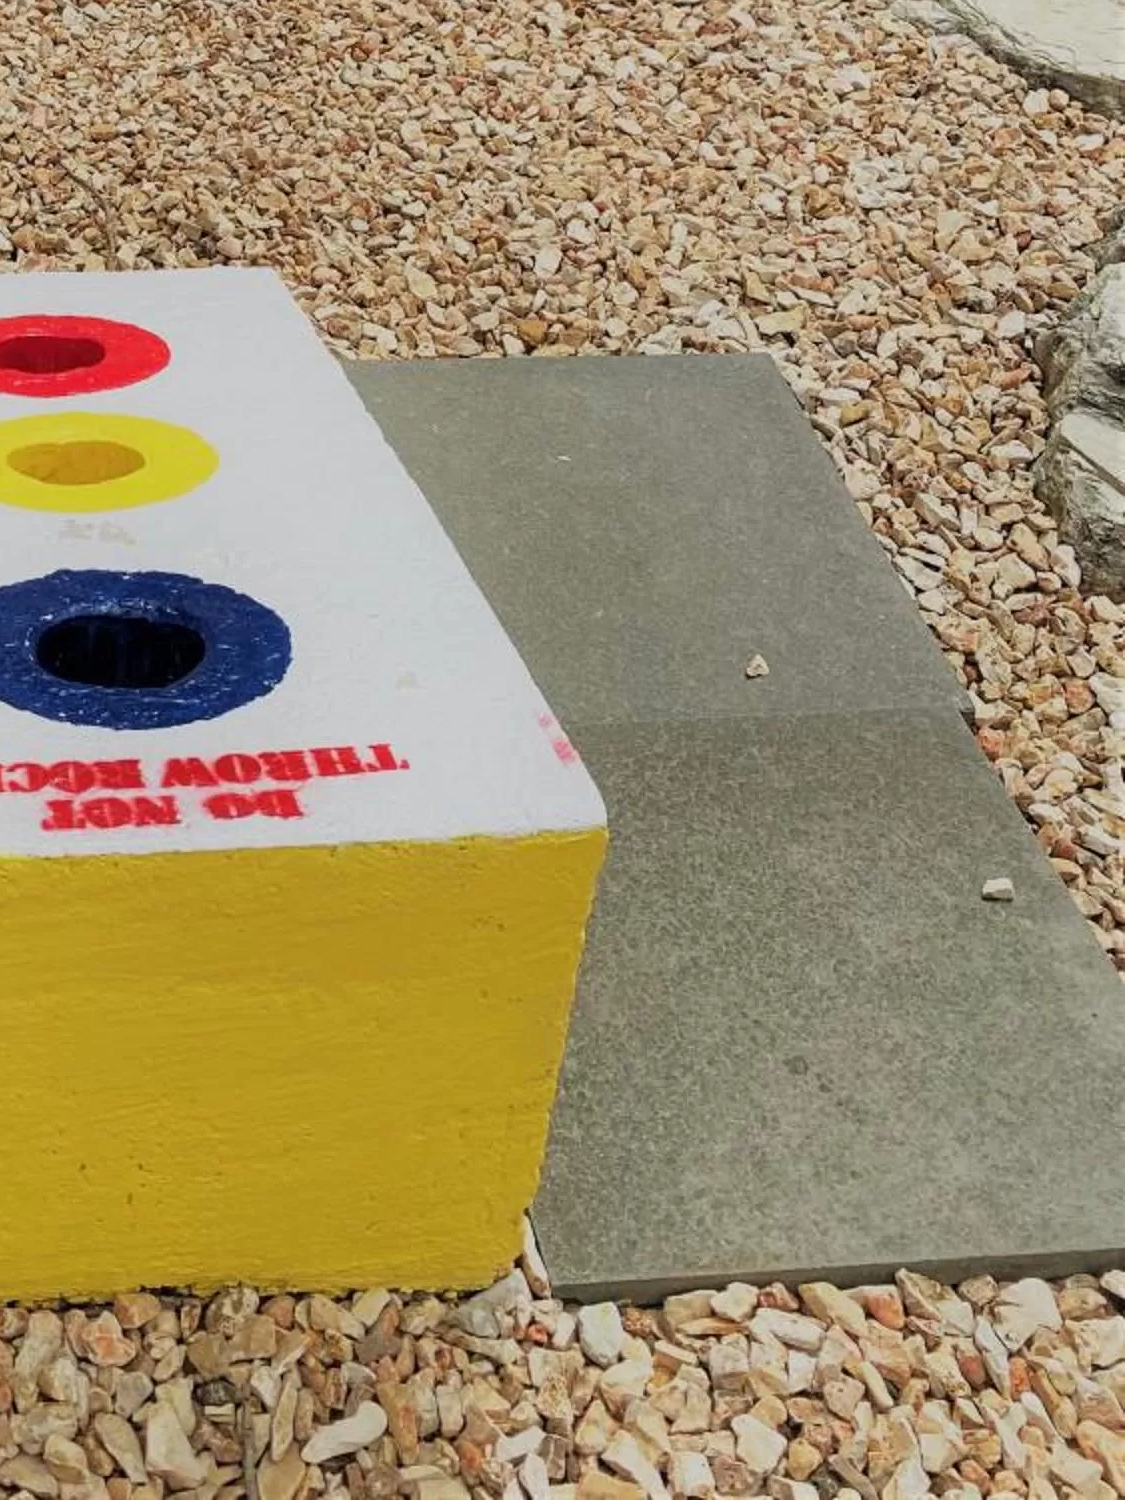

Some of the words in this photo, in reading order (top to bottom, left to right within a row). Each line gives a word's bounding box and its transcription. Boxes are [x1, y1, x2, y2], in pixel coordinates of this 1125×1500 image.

[161, 743, 410, 789] THROW
[42, 795, 182, 832] NOT
[203, 789, 304, 821] DO
